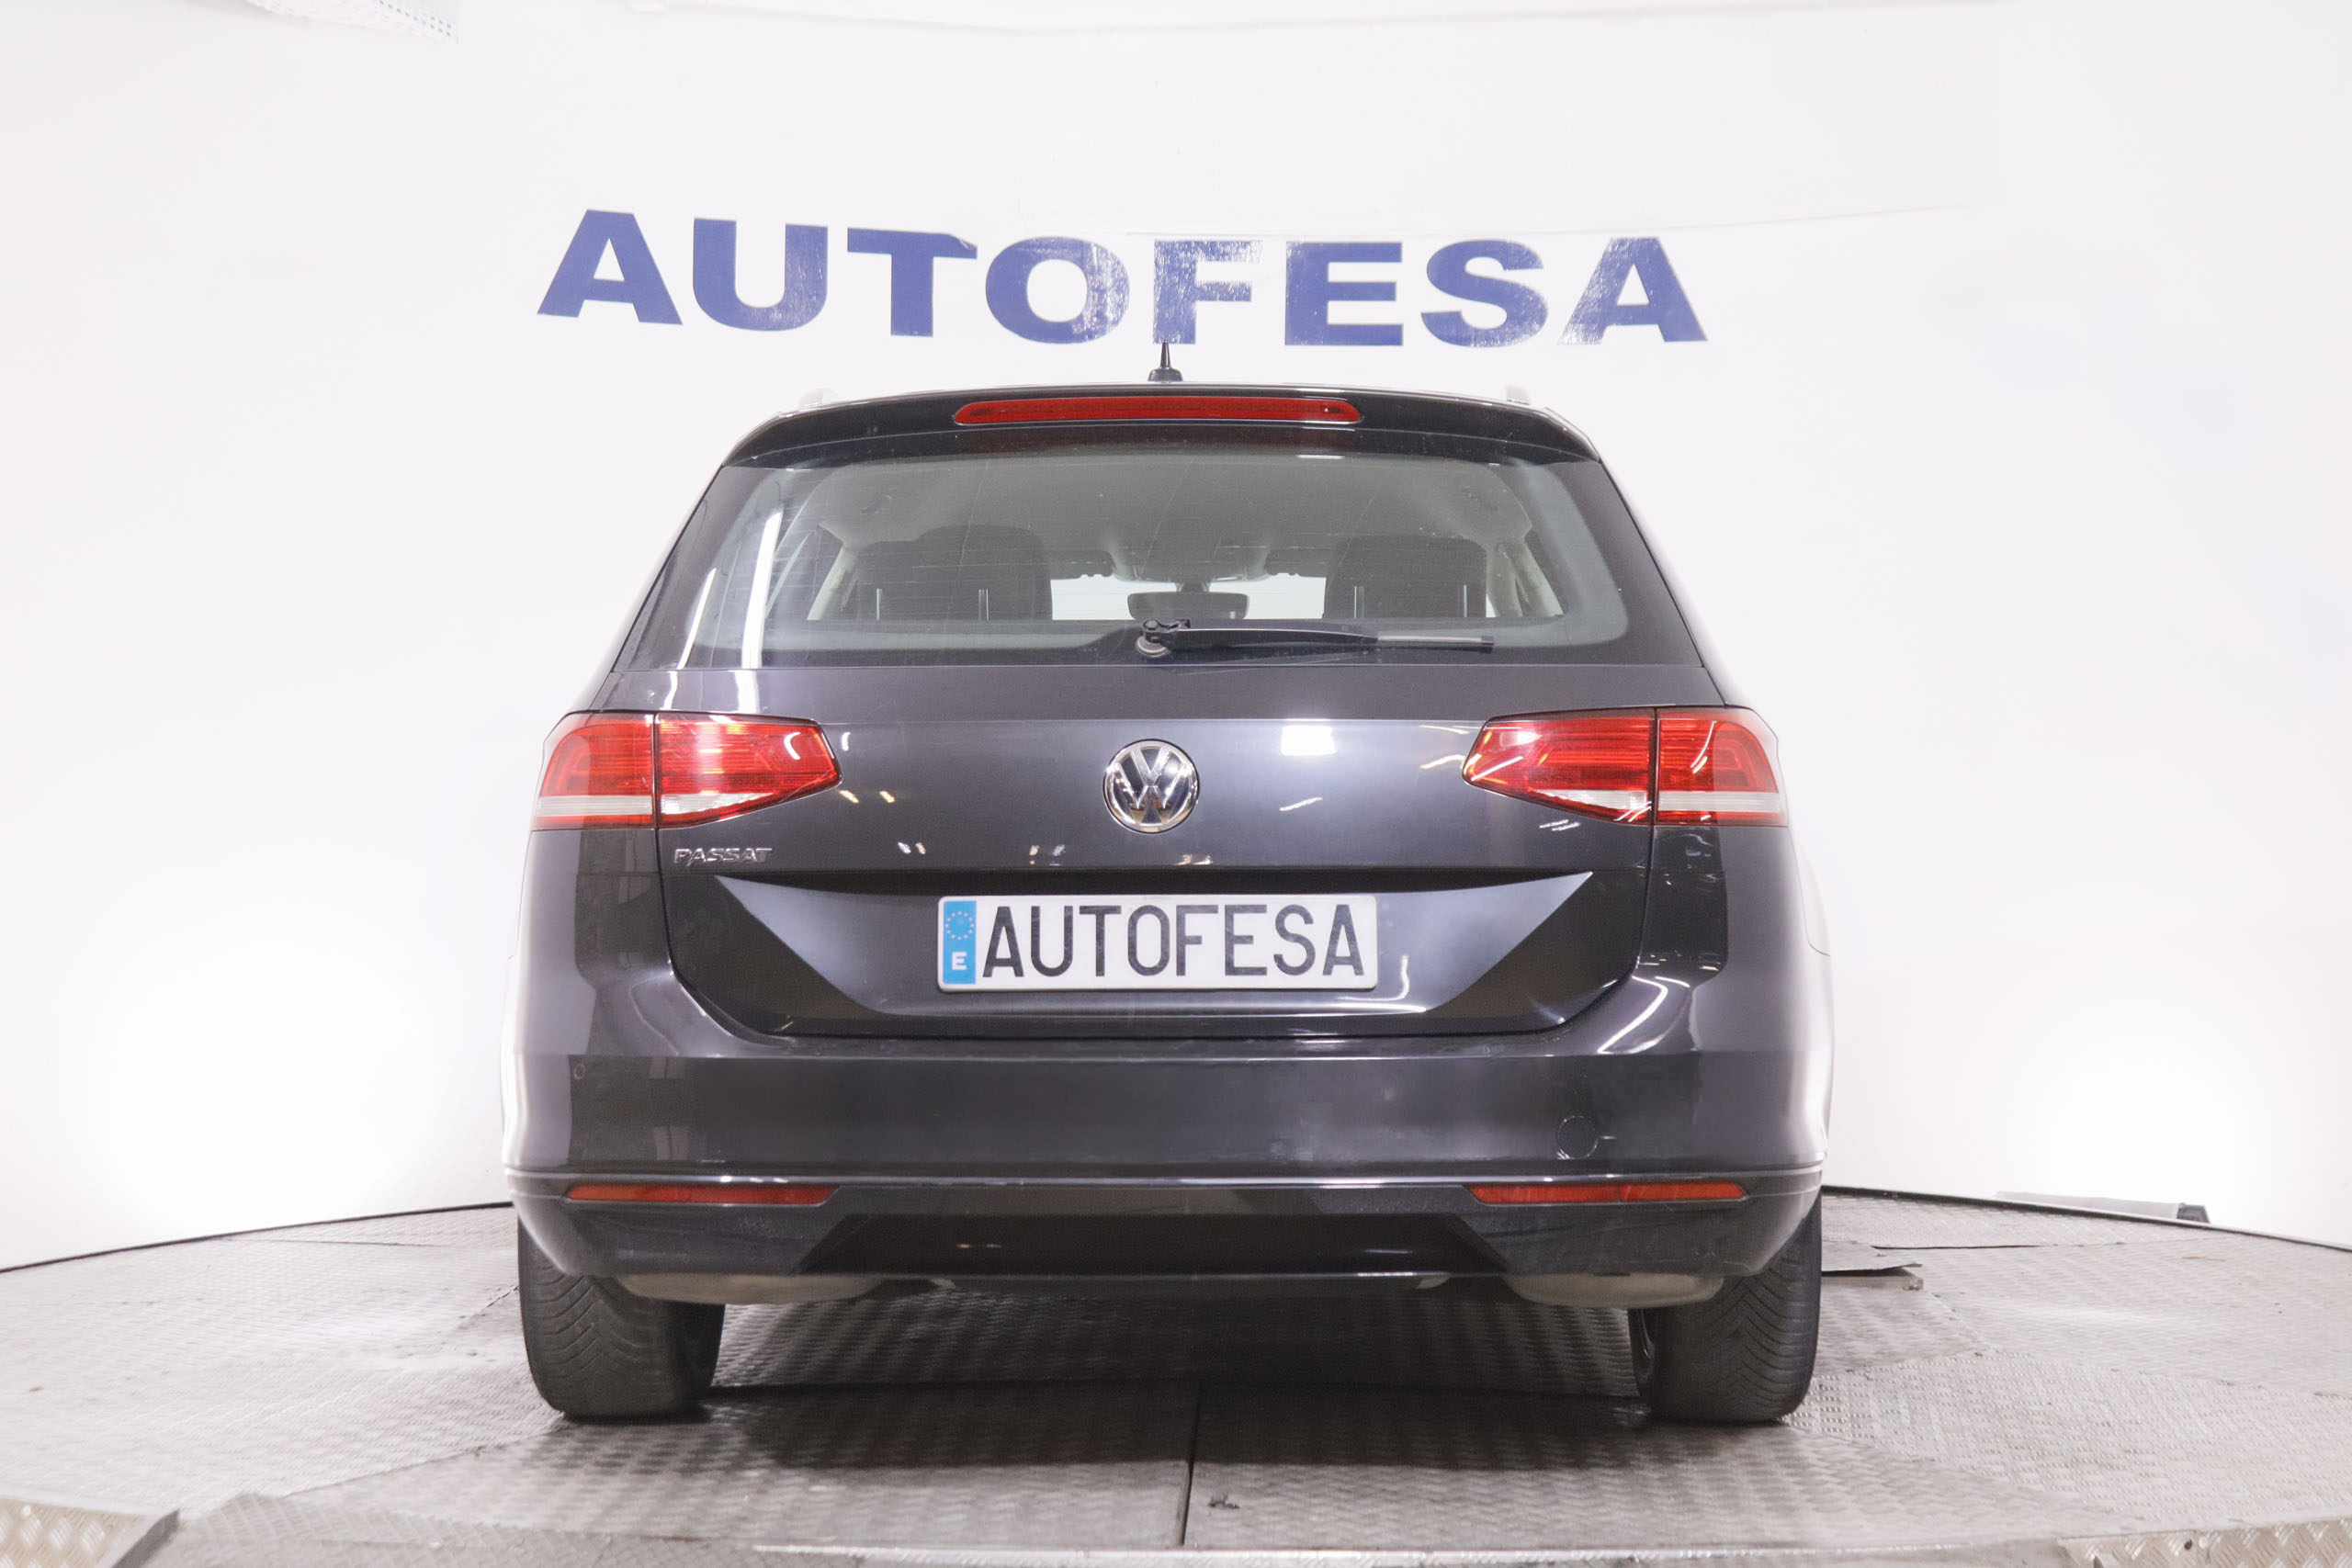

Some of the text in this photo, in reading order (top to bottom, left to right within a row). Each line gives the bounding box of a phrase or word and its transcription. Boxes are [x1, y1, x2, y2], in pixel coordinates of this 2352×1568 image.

[537, 208, 1709, 347] AUTOFESA
[673, 848, 773, 866] PASSAT
[952, 952, 967, 971] E
[982, 904, 1365, 977] AUTOFESA
